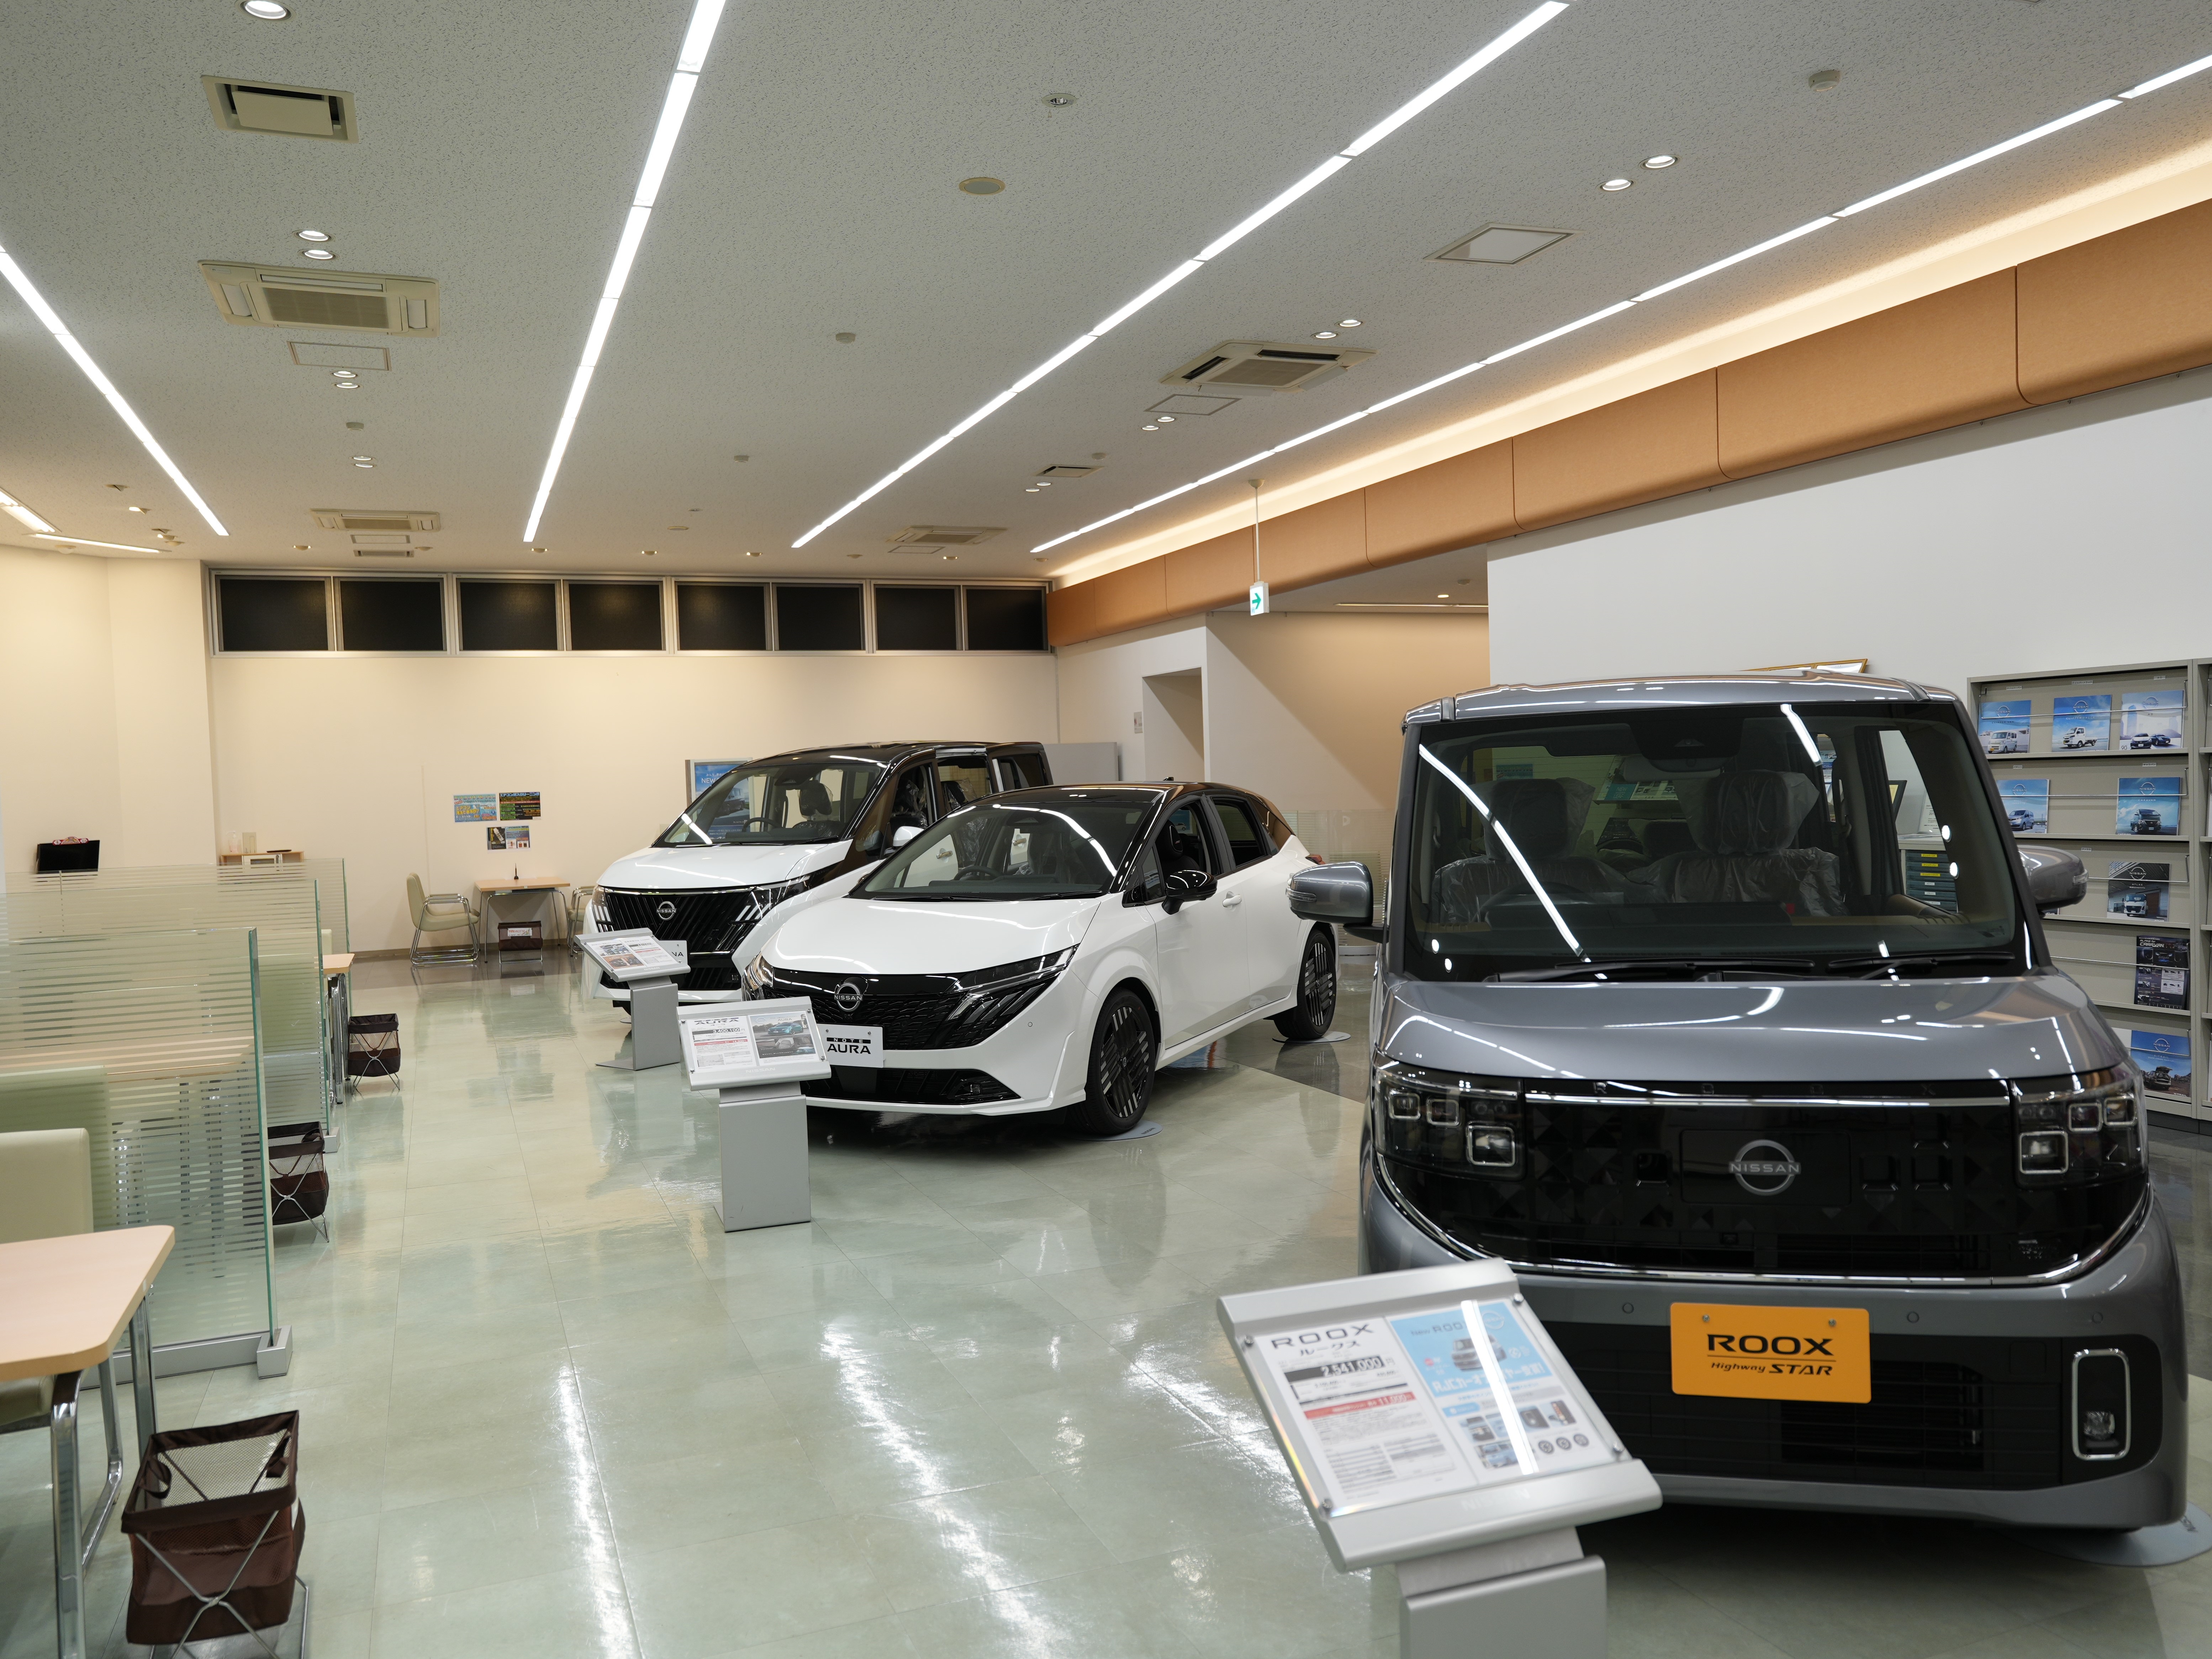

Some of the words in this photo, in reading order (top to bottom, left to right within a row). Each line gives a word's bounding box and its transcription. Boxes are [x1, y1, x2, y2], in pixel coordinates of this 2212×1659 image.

[827, 1044, 871, 1054] AURA
[1731, 1164, 1799, 1173] NISSAN
[1432, 1322, 1467, 1333] ROO
[1271, 1323, 1374, 1349] ROOX
[1300, 1340, 1361, 1357] ルークス
[1707, 1334, 1834, 1356] ROOX
[1320, 1357, 1383, 1378] 2,541,000
[1711, 1362, 1766, 1373] Highway
[1768, 1364, 1833, 1376] STAR
